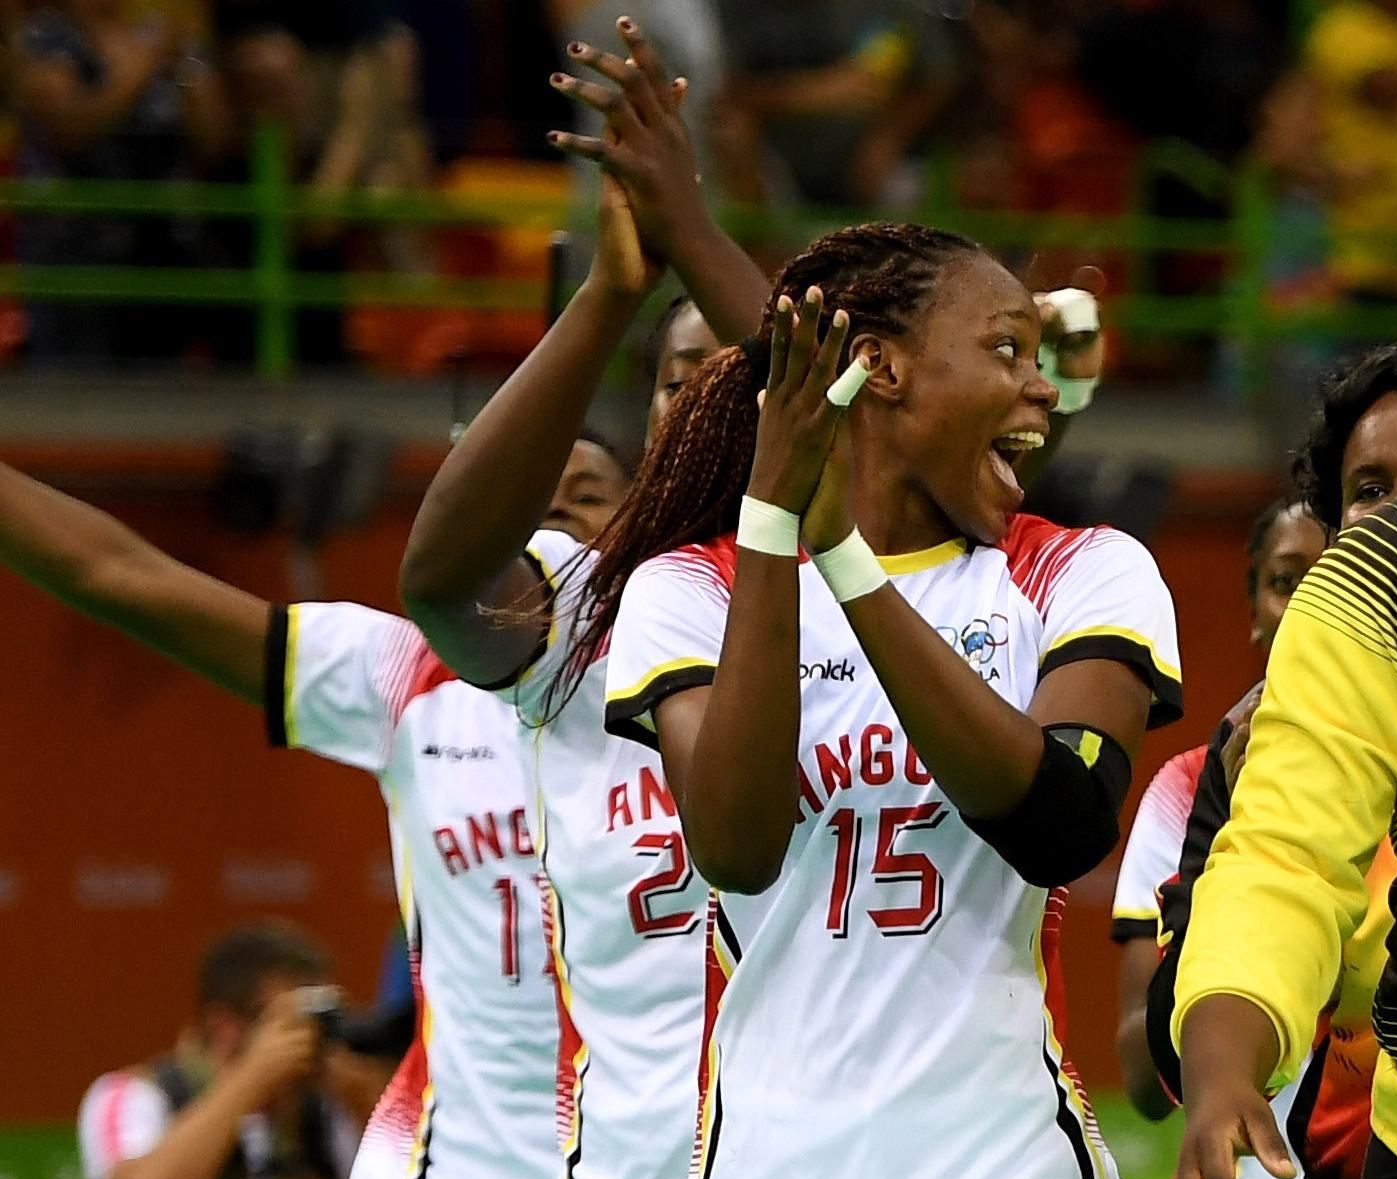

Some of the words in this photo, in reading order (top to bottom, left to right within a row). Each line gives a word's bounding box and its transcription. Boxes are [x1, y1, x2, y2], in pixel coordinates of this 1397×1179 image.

[799, 658, 855, 682] onick
[433, 806, 535, 876] ANG
[826, 801, 950, 940] 15
